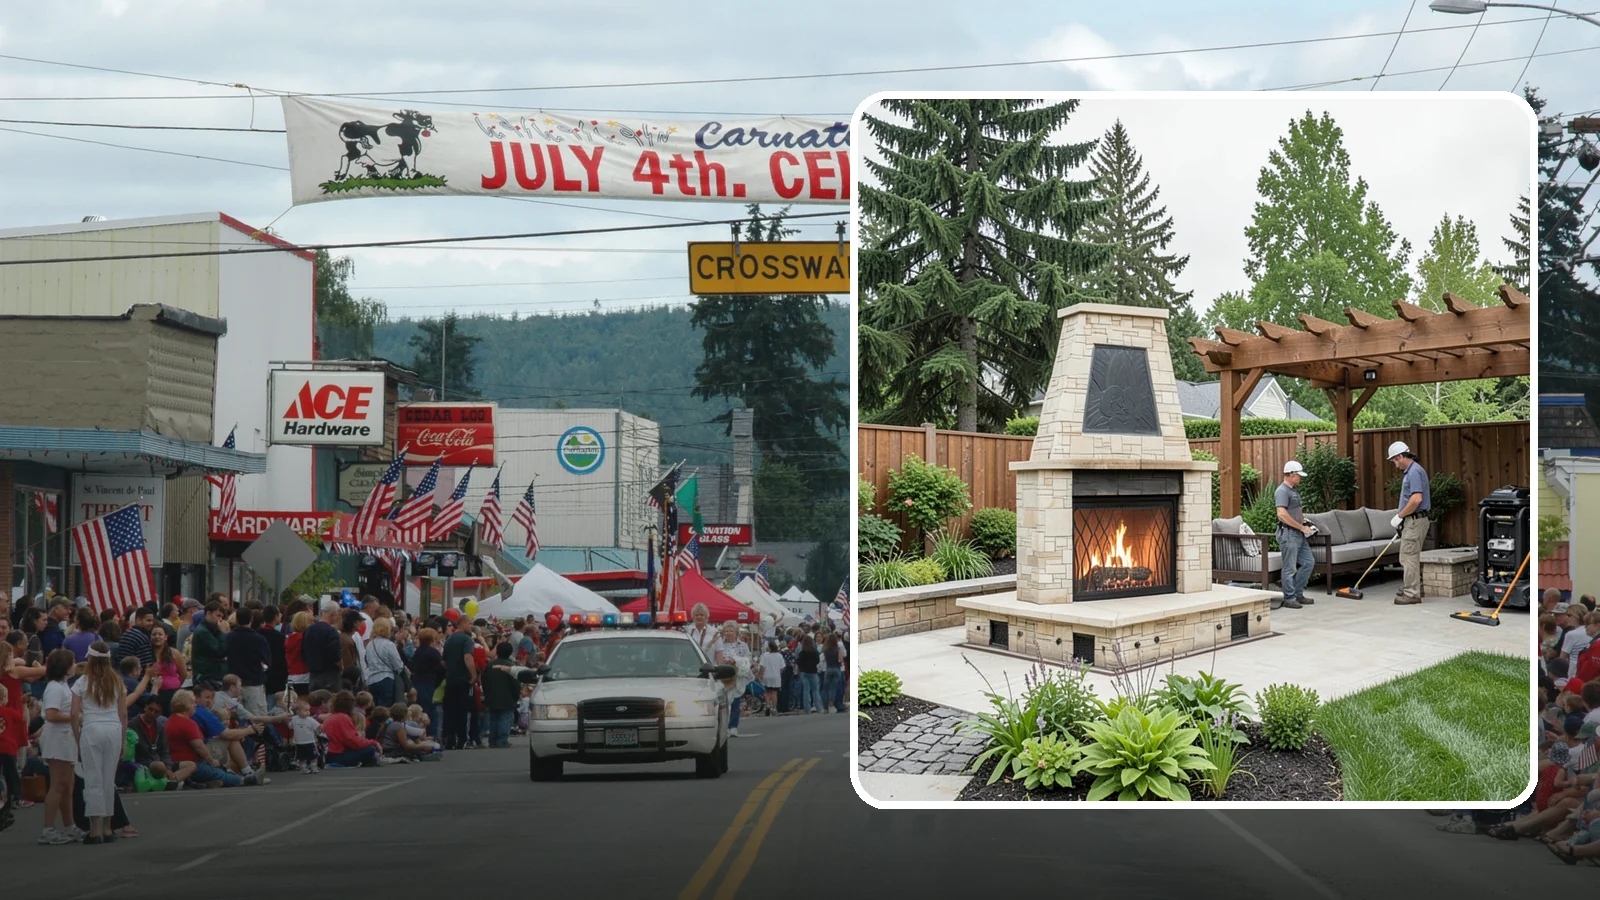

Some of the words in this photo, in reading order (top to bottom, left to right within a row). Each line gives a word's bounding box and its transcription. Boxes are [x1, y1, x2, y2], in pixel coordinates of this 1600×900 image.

[695, 121, 850, 150] Carnat
[481, 140, 605, 192] JULY
[632, 149, 746, 198] 4th.
[697, 254, 850, 280] CROSSWA
[282, 380, 374, 420] ACE
[406, 409, 453, 421] CEDAR
[283, 420, 371, 437] Hardware
[354, 467, 384, 480] Simpl
[95, 485, 124, 495] Vincent
[126, 485, 136, 495] de
[138, 485, 155, 496] Paul
[688, 526, 741, 535] CRNATION
[699, 535, 730, 543] GLASS
